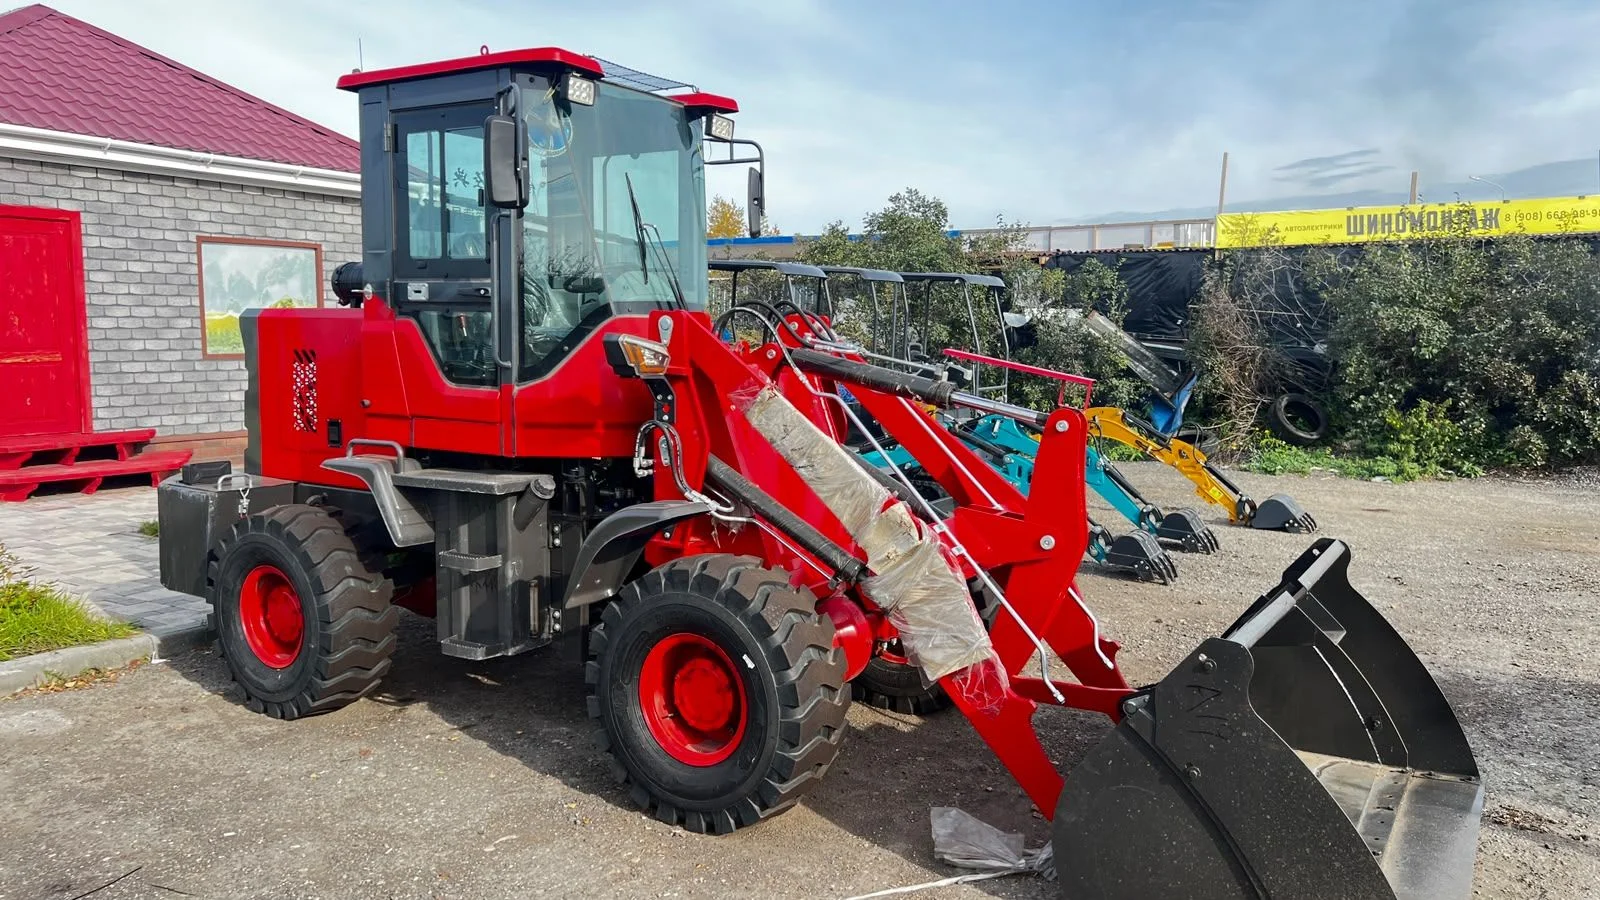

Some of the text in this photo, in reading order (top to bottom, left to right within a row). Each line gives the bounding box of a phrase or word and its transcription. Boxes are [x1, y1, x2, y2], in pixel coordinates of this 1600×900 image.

[1346, 208, 1500, 236] ШИНОМОНТАЖ
[1504, 208, 1600, 223] 8 (908) 668-98-9
[1284, 223, 1343, 232] АВТОЭЛЕКТРИКИ
